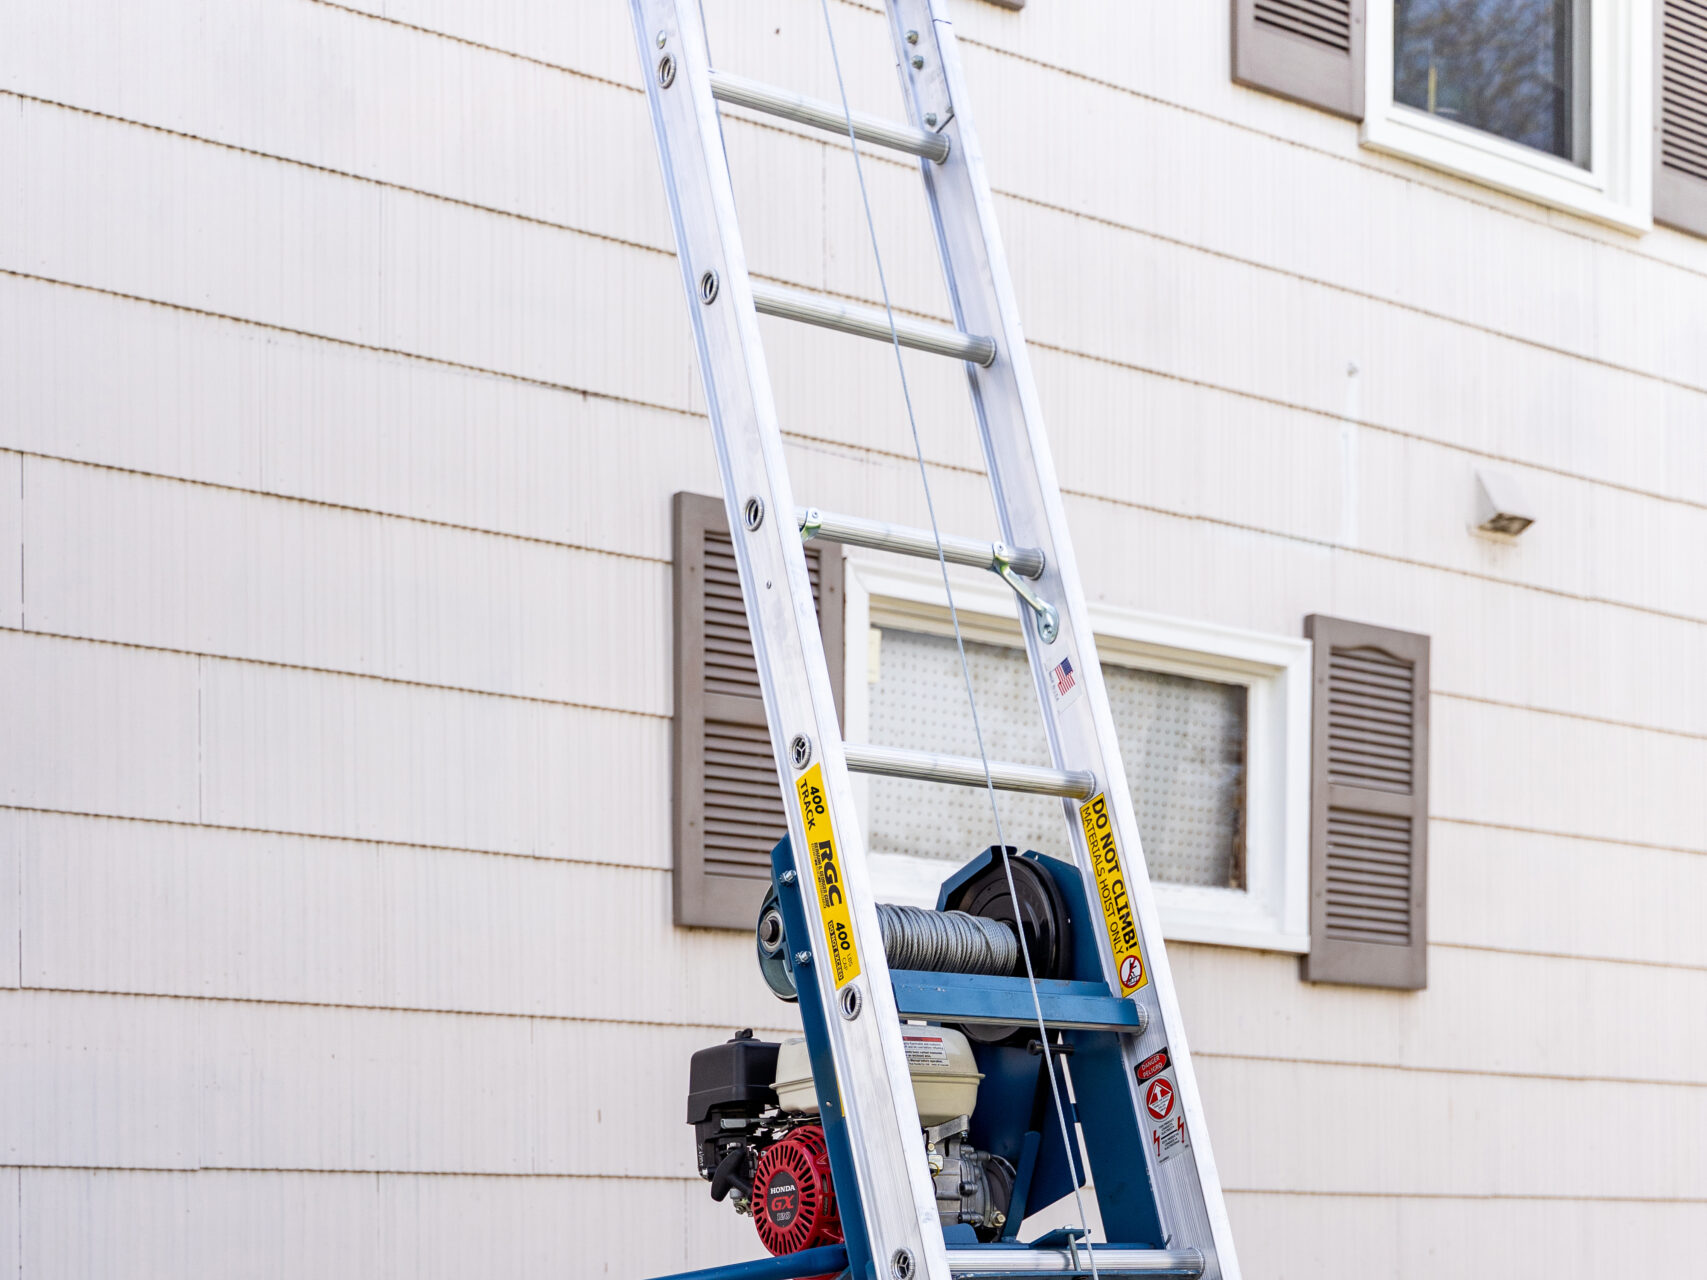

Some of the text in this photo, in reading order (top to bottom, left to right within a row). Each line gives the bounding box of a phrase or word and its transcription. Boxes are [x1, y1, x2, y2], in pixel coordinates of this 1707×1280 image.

[800, 778, 816, 831] TRACK
[810, 786, 825, 815] 400
[818, 840, 842, 907] RGC
[1083, 806, 1125, 955] MATERIALS HOIST ONLY
[1092, 797, 1138, 952] DO NOT CLIMB!
[836, 922, 851, 951] 400
[1141, 1055, 1161, 1071] DANGER
[1142, 1062, 1164, 1077] PELIGRO
[770, 1184, 796, 1194] HONDA
[771, 1194, 795, 1212] GX
